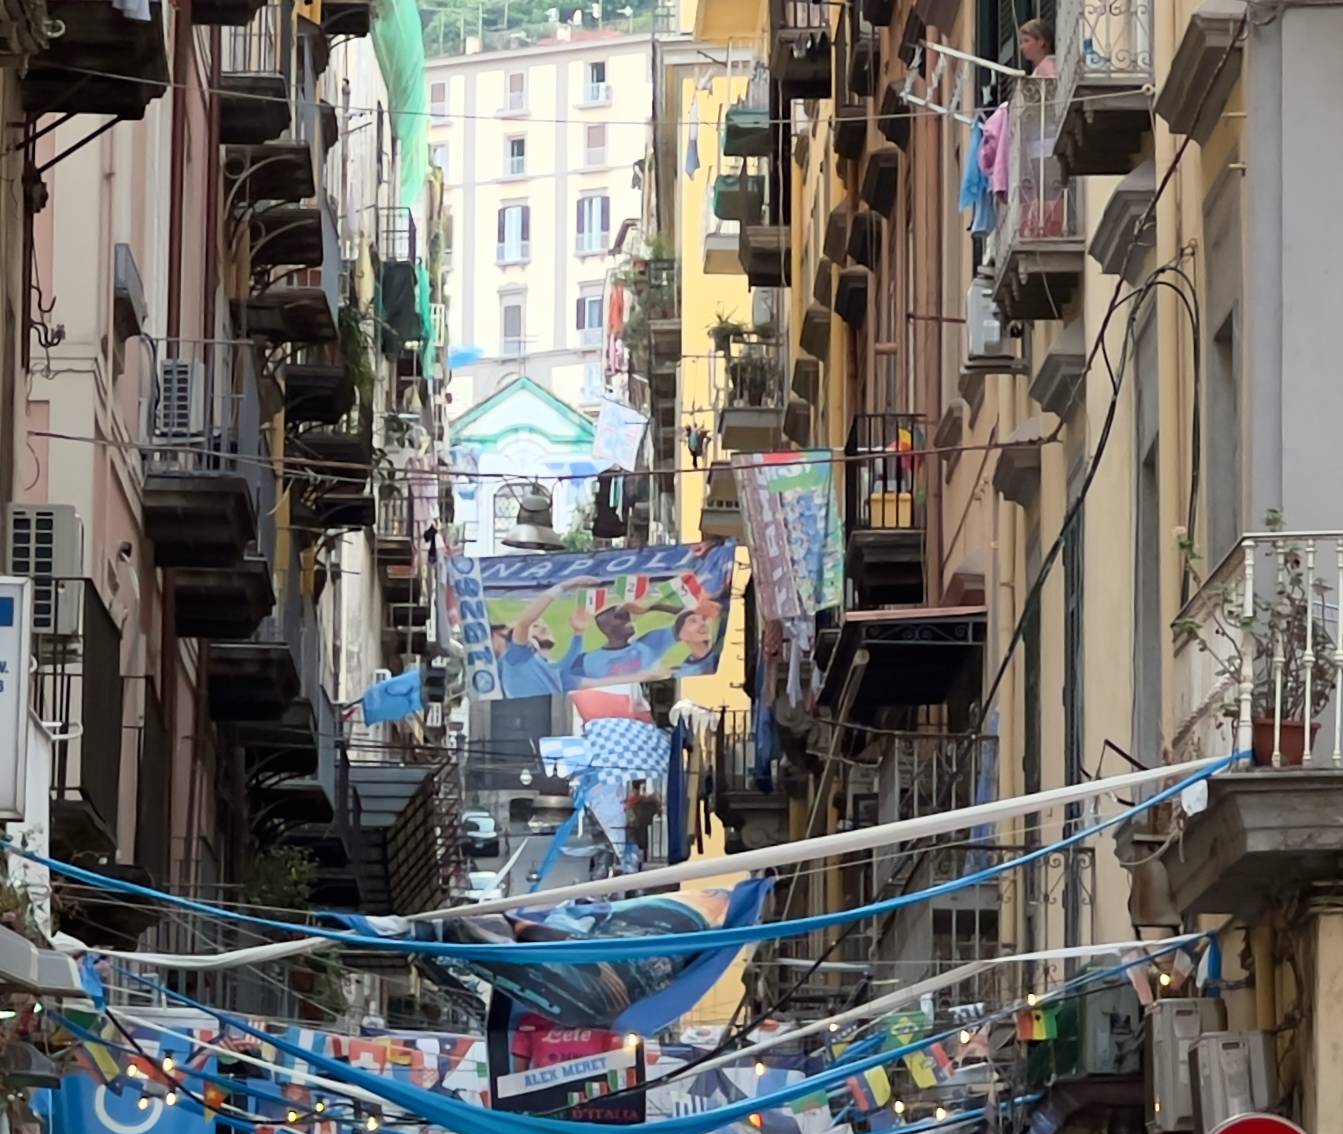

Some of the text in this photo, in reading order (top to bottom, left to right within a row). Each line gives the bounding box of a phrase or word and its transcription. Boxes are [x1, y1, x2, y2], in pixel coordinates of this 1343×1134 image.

[483, 549, 693, 578] NAPOLI
[524, 1057, 607, 1087] ALEX MERET
